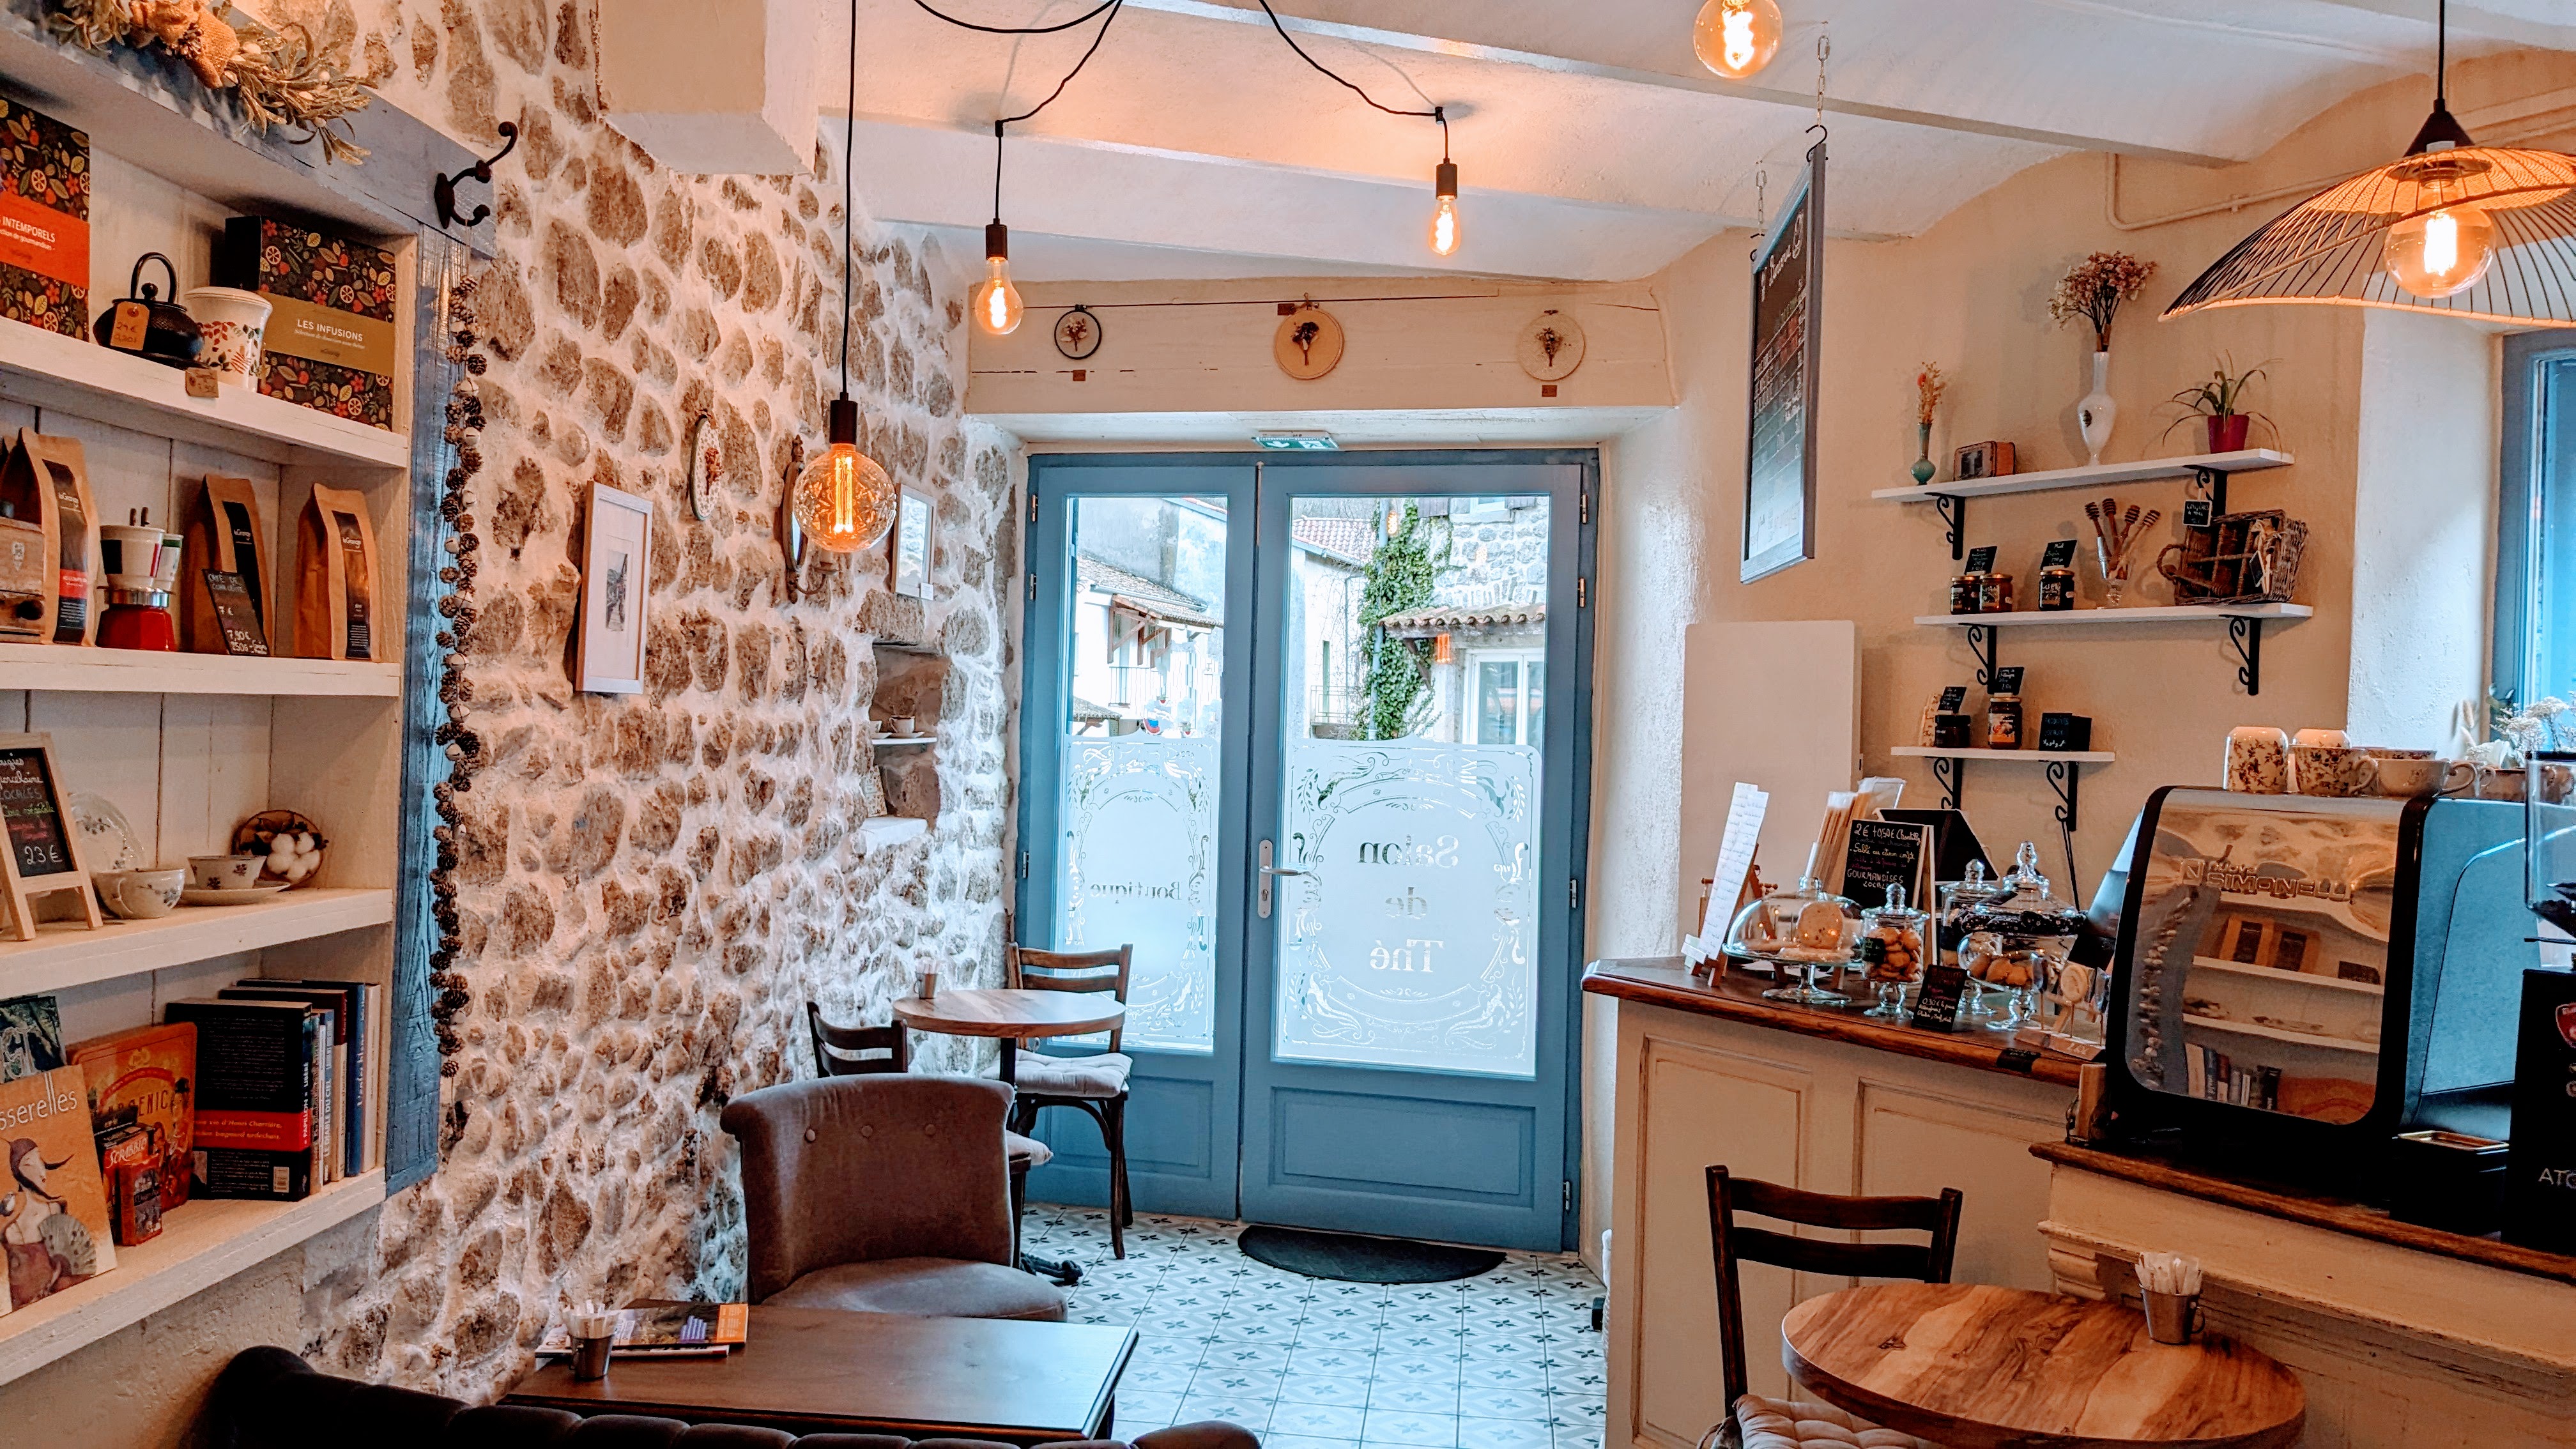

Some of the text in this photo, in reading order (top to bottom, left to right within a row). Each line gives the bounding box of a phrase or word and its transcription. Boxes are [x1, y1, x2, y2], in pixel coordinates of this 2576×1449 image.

[3, 216, 56, 242] INTEMPORELS
[297, 319, 364, 342] LES INFUSIONS
[24, 844, 63, 865] 23 €
[1847, 868, 1904, 884] GOURMANDISES
[2206, 871, 2352, 902] SIMONELLI
[108, 1089, 169, 1117] ENIC
